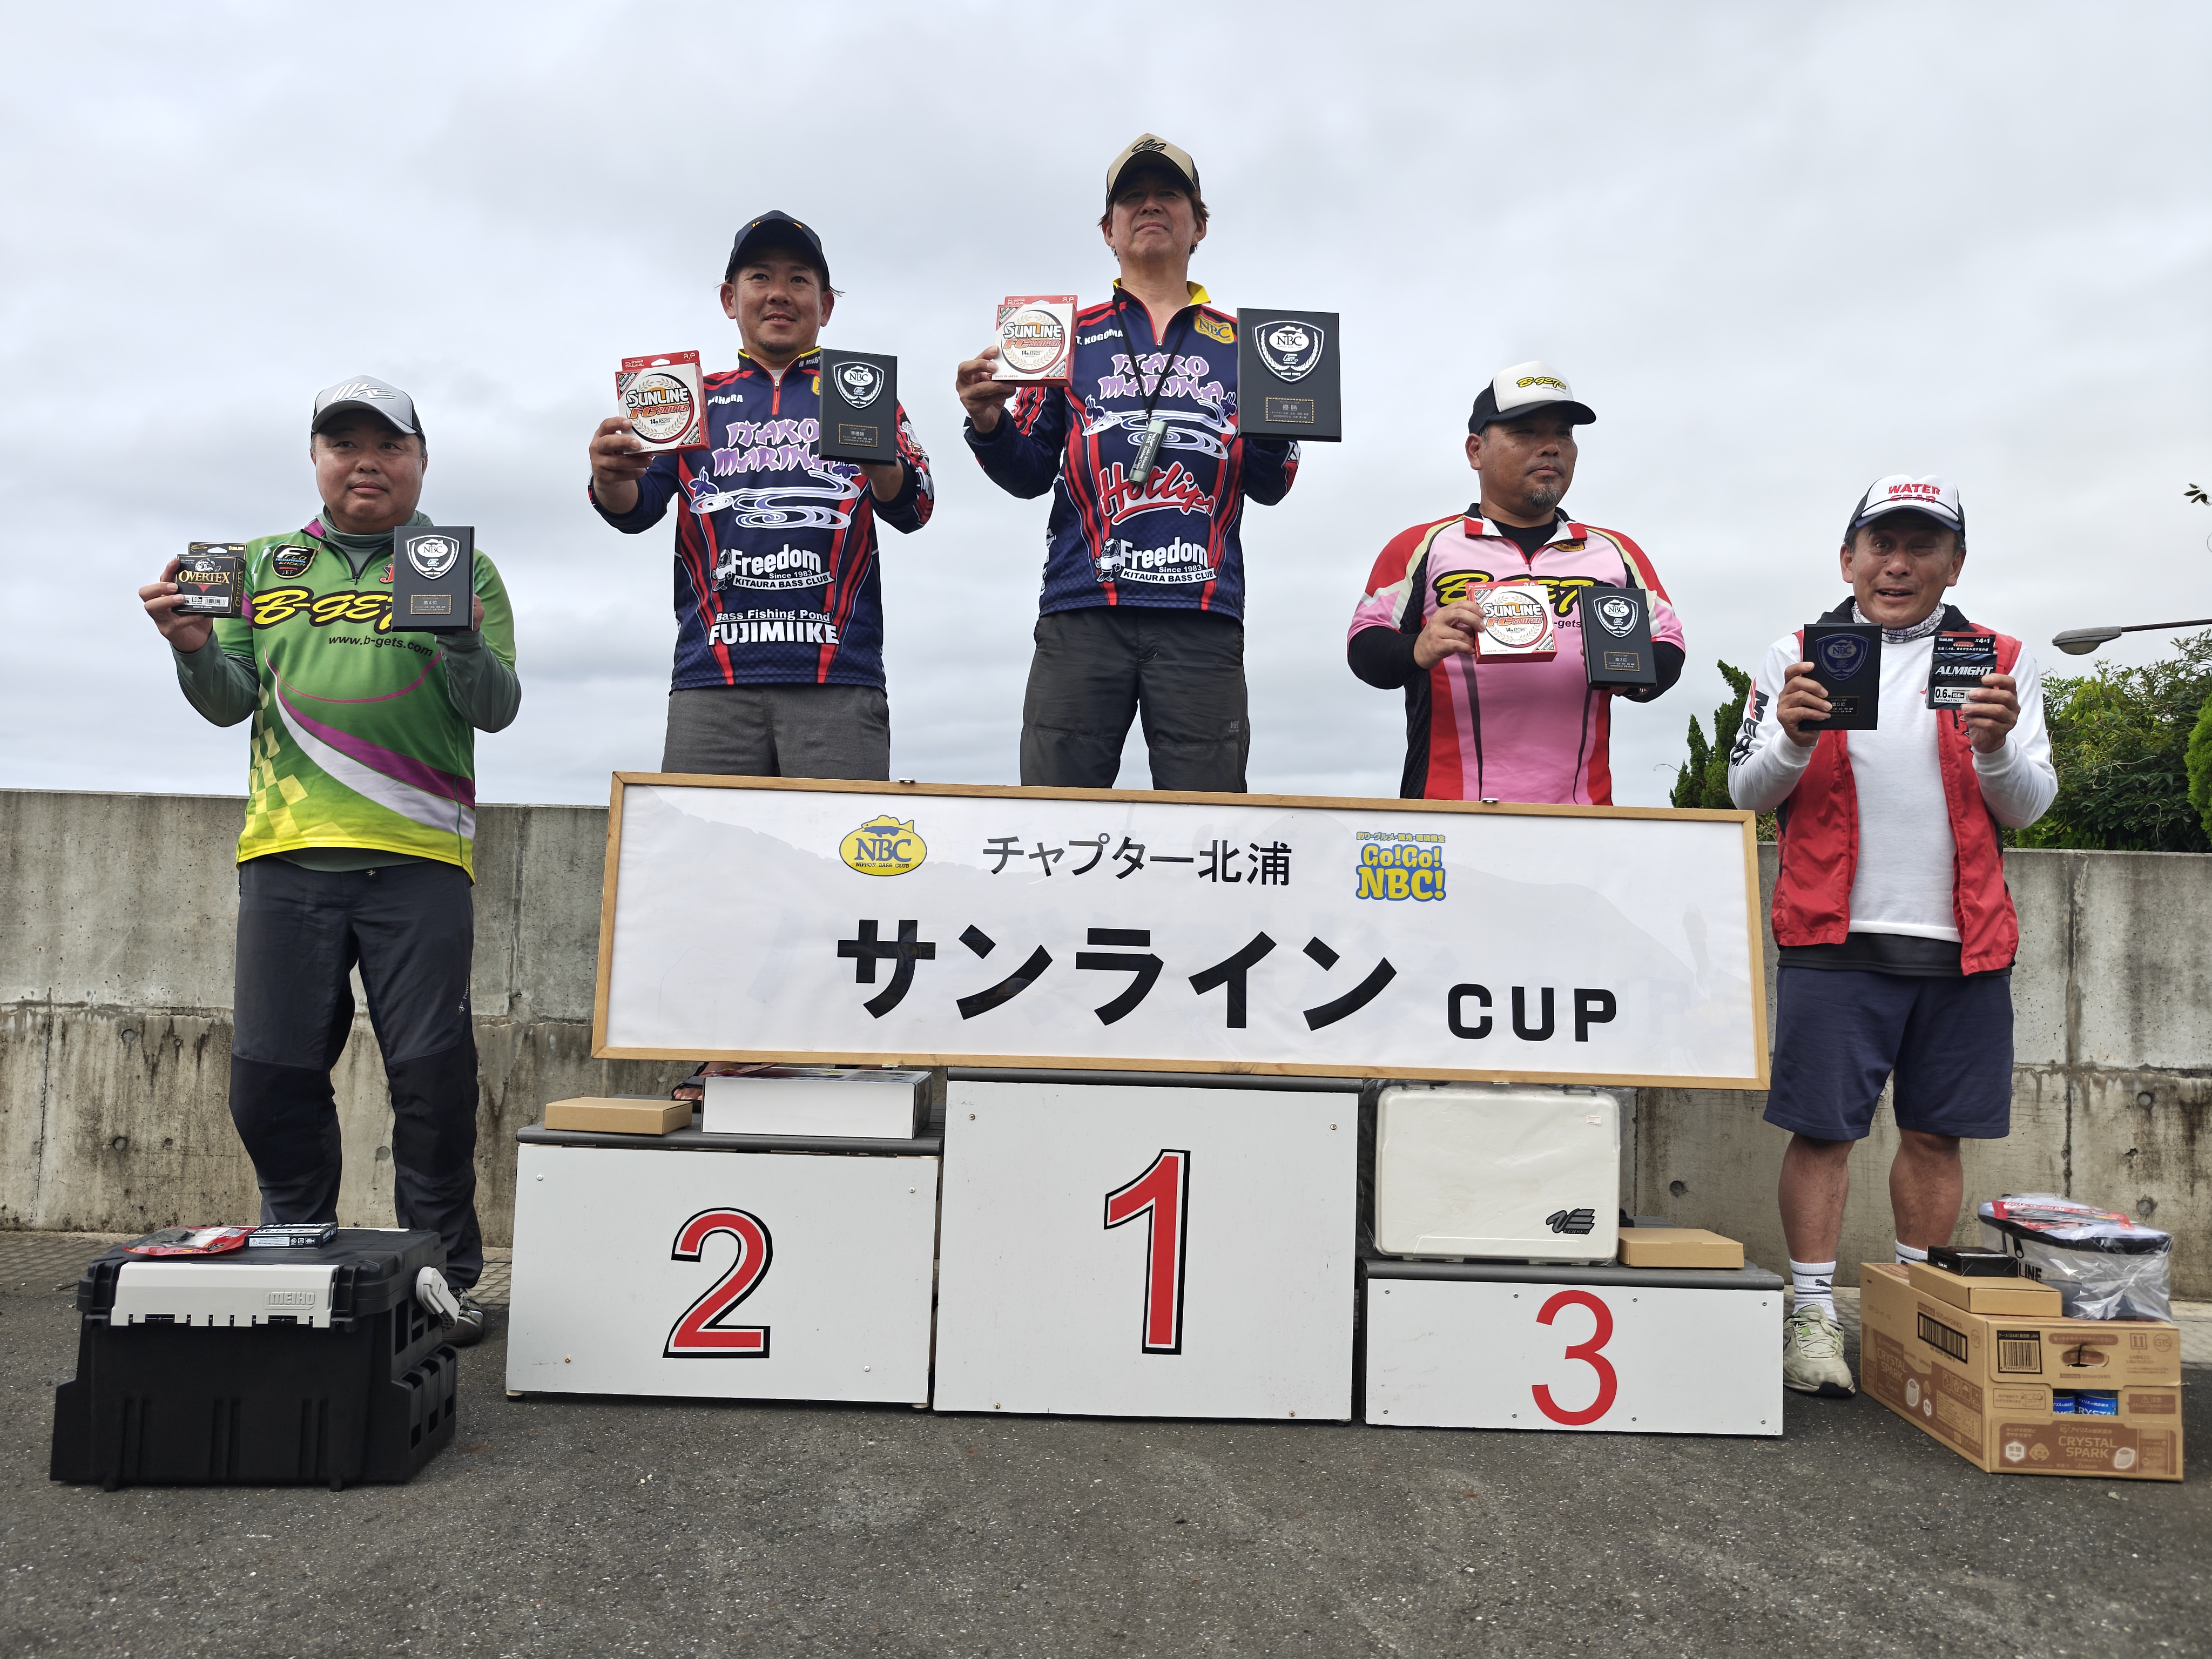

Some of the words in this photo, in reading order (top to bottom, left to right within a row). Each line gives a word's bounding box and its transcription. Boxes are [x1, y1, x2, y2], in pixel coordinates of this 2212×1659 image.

[1003, 322, 1062, 338] SUNLINE
[1075, 336, 1082, 345] T.
[1084, 328, 1123, 345] KOGOMA
[1198, 318, 1231, 339] NBC
[1003, 338, 1031, 349] FC
[1277, 335, 1303, 346] NBC
[1111, 353, 1210, 377] ITAKO
[849, 373, 868, 382] NBC
[1516, 377, 1566, 389] B-GETS
[626, 387, 689, 408] SUNLINE
[1097, 375, 1224, 404] MARINA
[629, 406, 657, 419] FC
[657, 404, 689, 415] SNIPER
[726, 419, 820, 447] ITAKO
[1100, 461, 1215, 517] Hotlips
[1888, 483, 1940, 495] WATER
[731, 544, 821, 576] Freedom
[1120, 537, 1208, 569] Freedom
[179, 570, 231, 584] OVERTEX
[735, 578, 776, 588] KITAURA
[806, 575, 829, 585] CLUB
[1123, 570, 1165, 582] KITAURA
[1195, 571, 1213, 580] CLUB
[716, 612, 743, 621] Bass
[747, 609, 795, 621] Fishing
[800, 610, 830, 622] Pond
[1483, 603, 1543, 617] SUNLINE
[1608, 605, 1626, 613] NBC
[1486, 617, 1512, 626] FC
[708, 622, 840, 645] FUJIMIIKE
[329, 635, 433, 657] www.b-gets.com
[1935, 666, 1993, 675] ALMIGHT
[854, 838, 912, 862] NBC
[983, 833, 1291, 885] チャプター北浦
[1363, 844, 1441, 868] Go!Go!
[1357, 866, 1444, 900] NBC!
[837, 920, 1397, 1031] サンライン
[1448, 984, 1616, 1042] CUP
[1104, 1149, 1190, 1355] 1
[663, 1207, 773, 1358] 2
[269, 1292, 315, 1305] MEIHO
[2155, 1339, 2171, 1347] G15
[1532, 1290, 1617, 1426] 3
[1877, 1348, 1907, 1373] CRYSTAL
[1881, 1361, 1903, 1383] SPARK
[2058, 1436, 2117, 1448] CRYSTAL
[2066, 1447, 2109, 1459] SPARK
